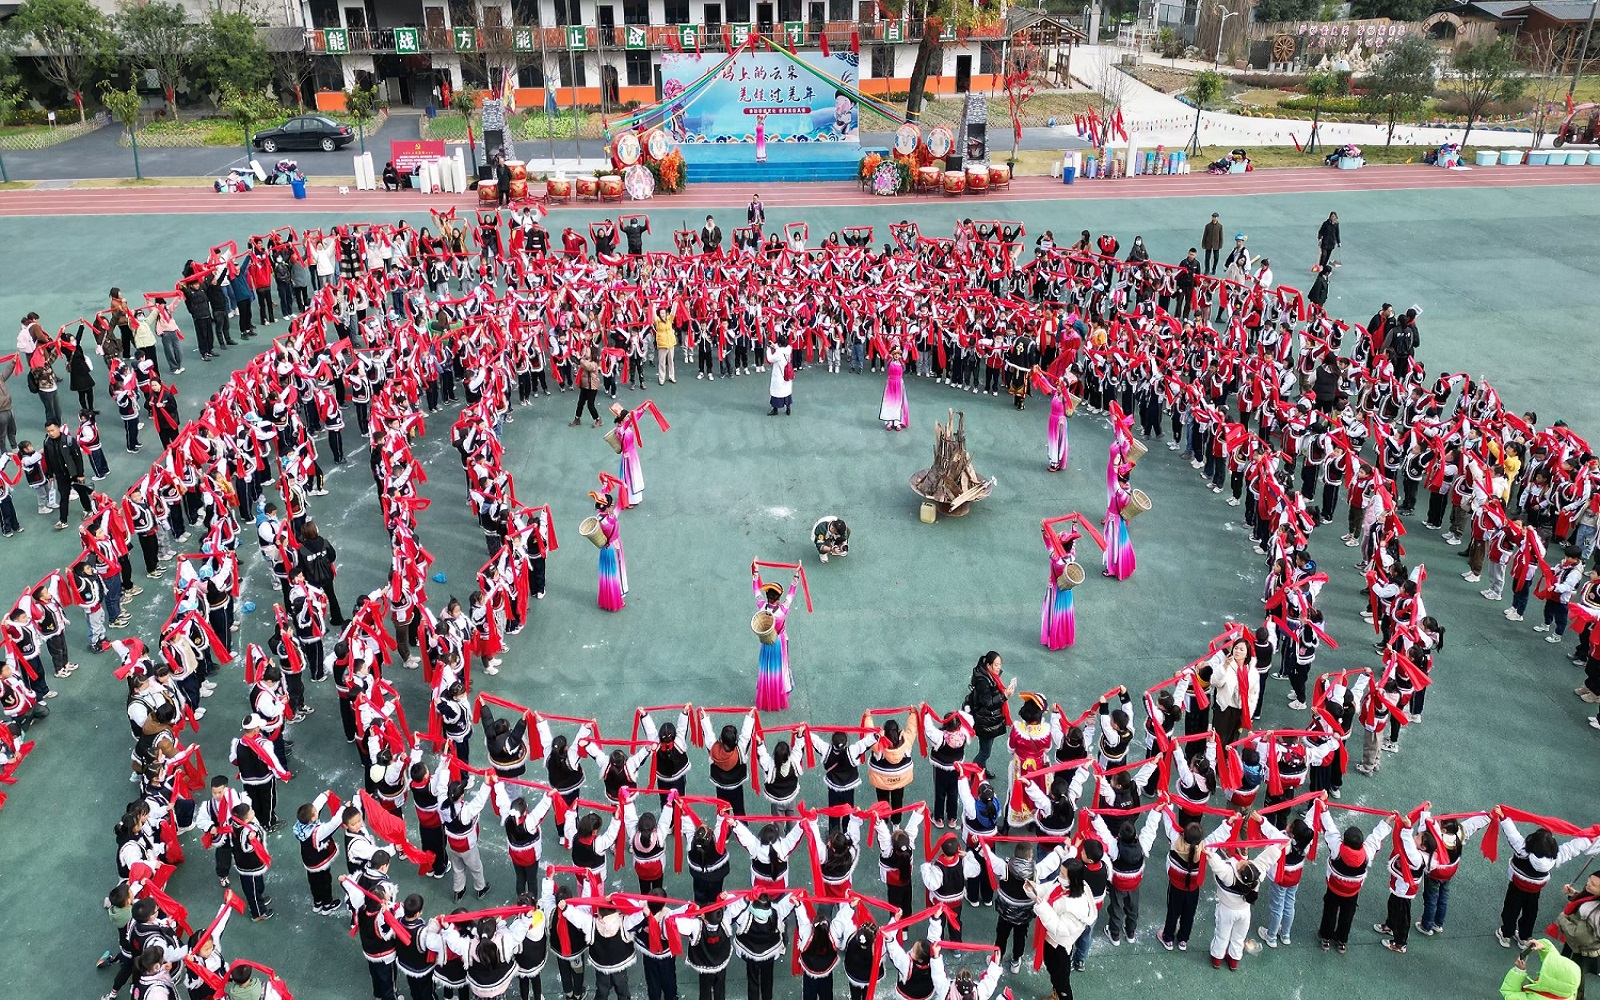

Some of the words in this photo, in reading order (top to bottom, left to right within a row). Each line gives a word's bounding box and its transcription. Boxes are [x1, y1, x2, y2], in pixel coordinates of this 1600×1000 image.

[327, 31, 346, 51] 能
[399, 31, 416, 51] 战
[457, 30, 472, 49] 方
[515, 30, 531, 48] 能
[683, 27, 696, 46] 自
[734, 26, 751, 44] 强
[787, 25, 802, 44] 才
[738, 85, 817, 104] 羌娃过羌年
